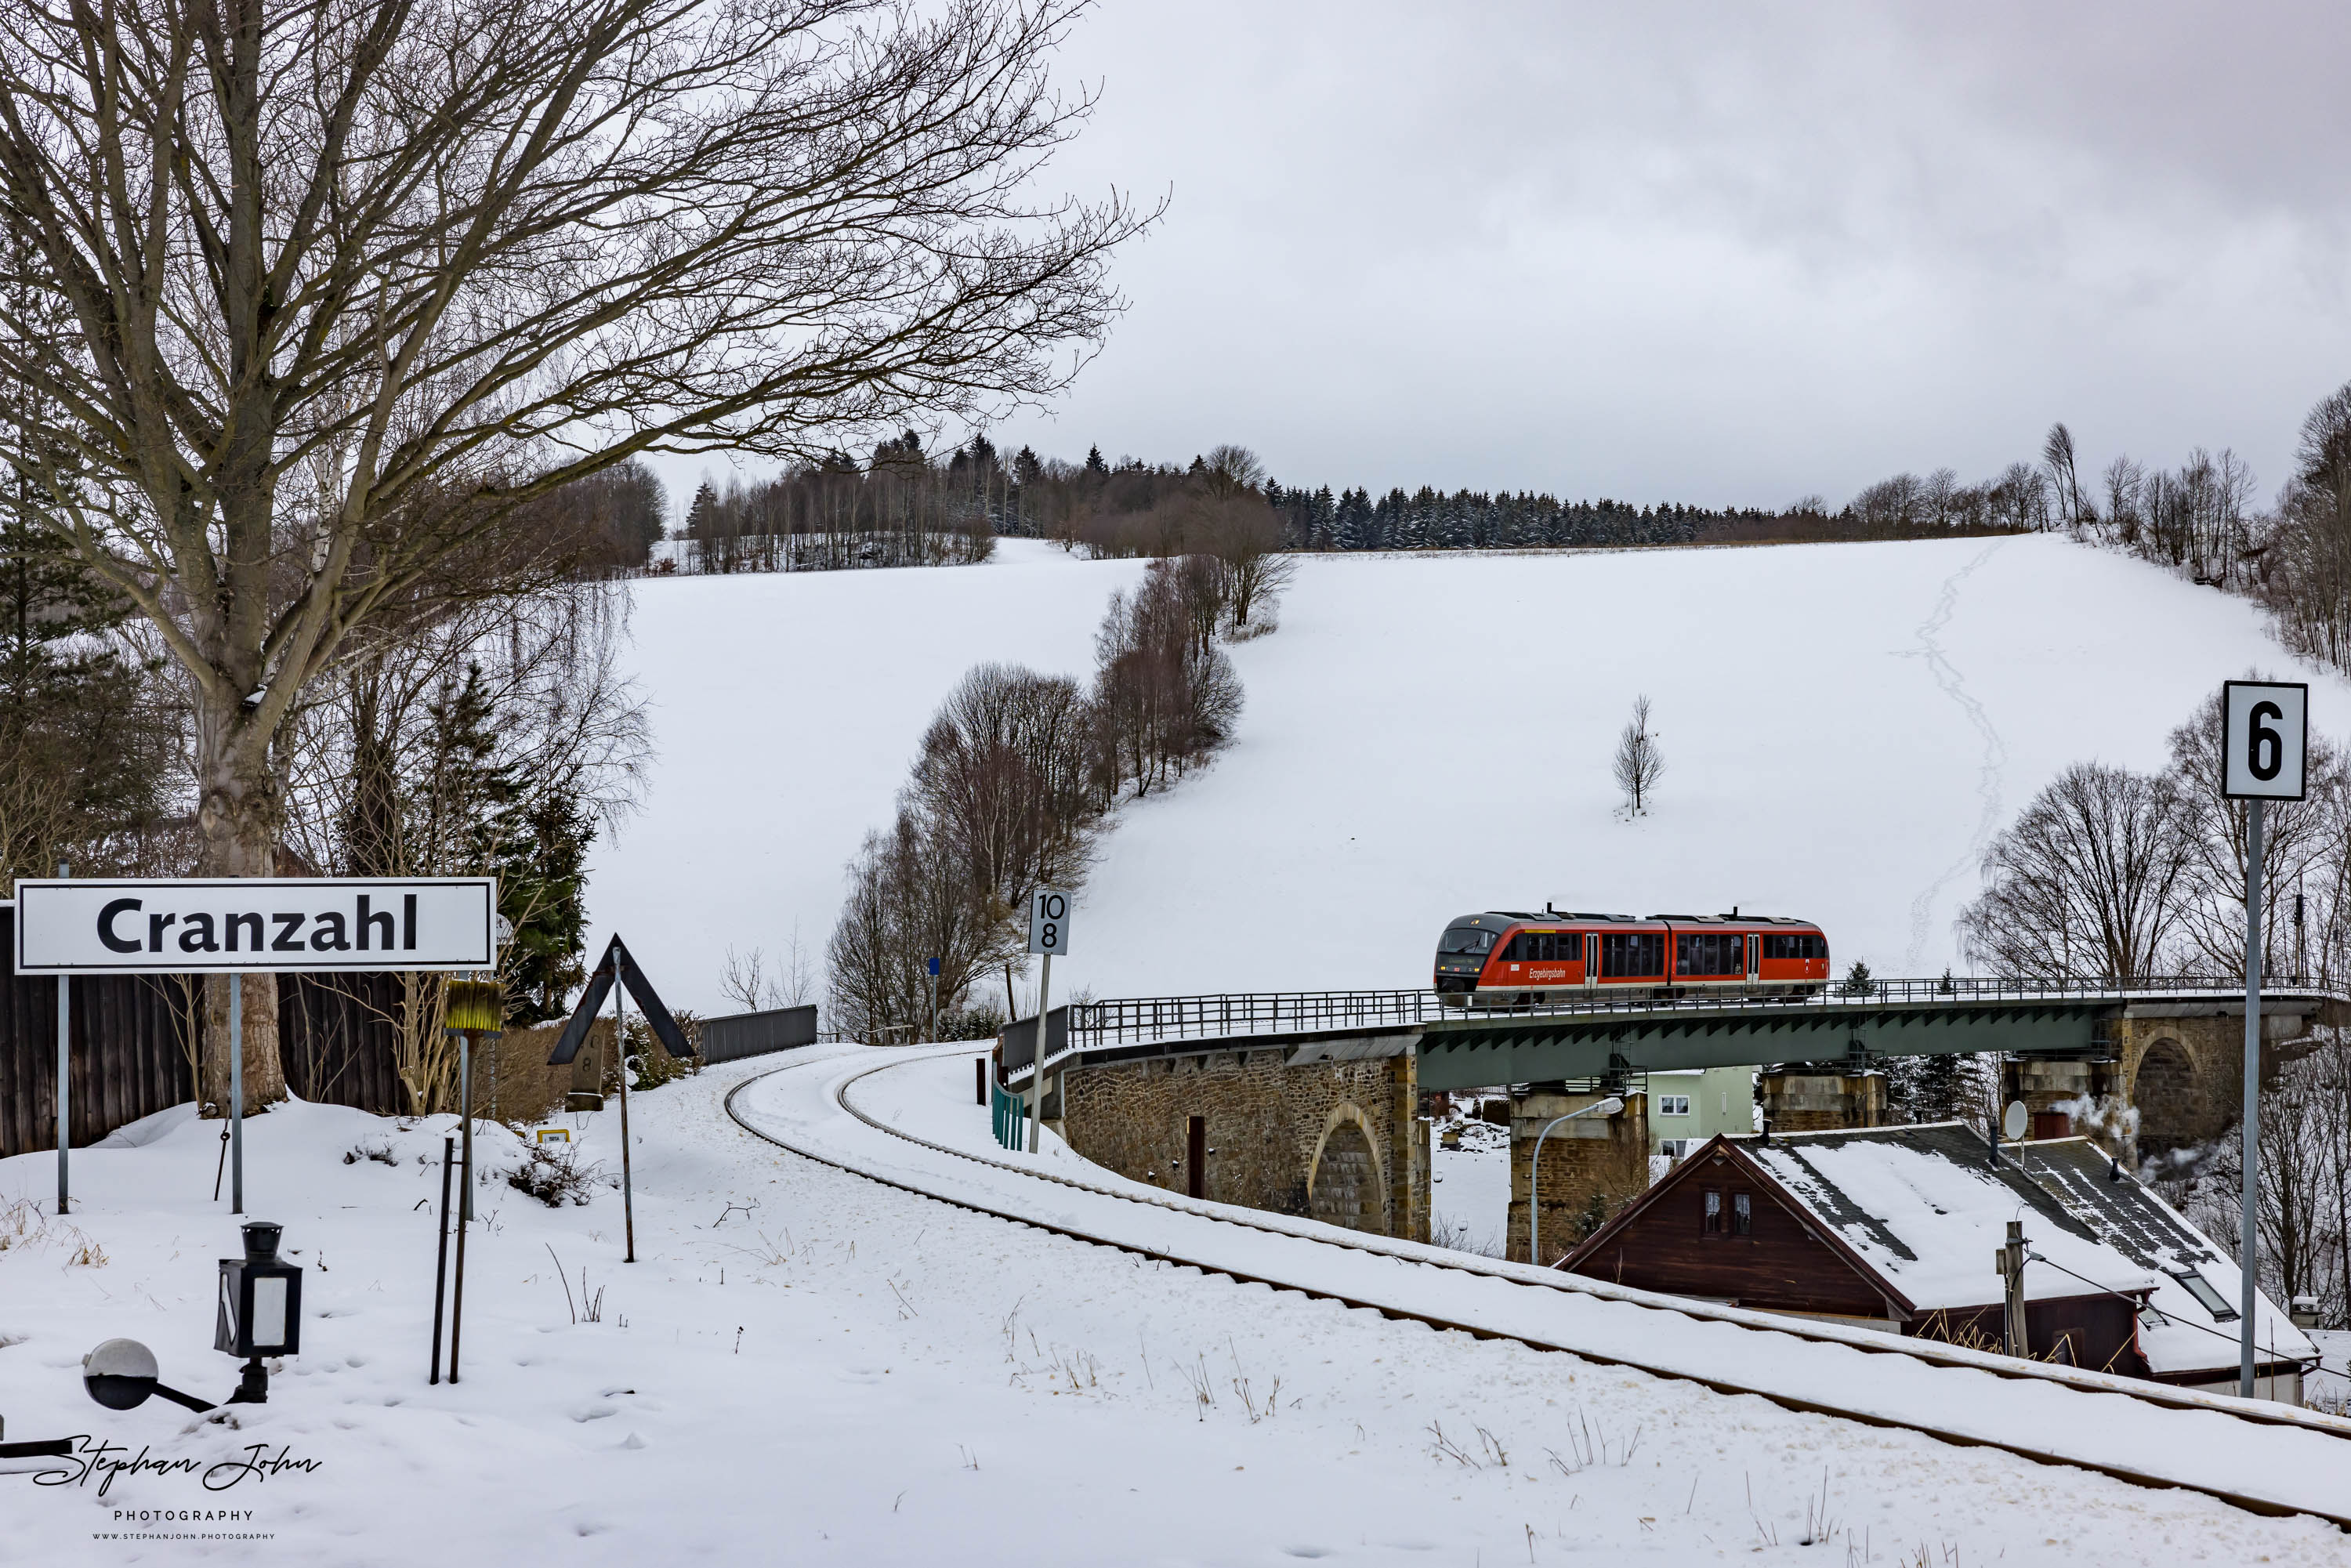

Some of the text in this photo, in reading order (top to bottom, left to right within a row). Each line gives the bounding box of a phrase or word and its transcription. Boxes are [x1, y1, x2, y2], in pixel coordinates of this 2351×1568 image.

[2248, 701, 2283, 781] 6
[1038, 894, 1066, 920] 10
[96, 893, 417, 954] Cranzahl
[1041, 922, 1057, 948] 8
[1529, 967, 1566, 980] Erzgebirgsbahn
